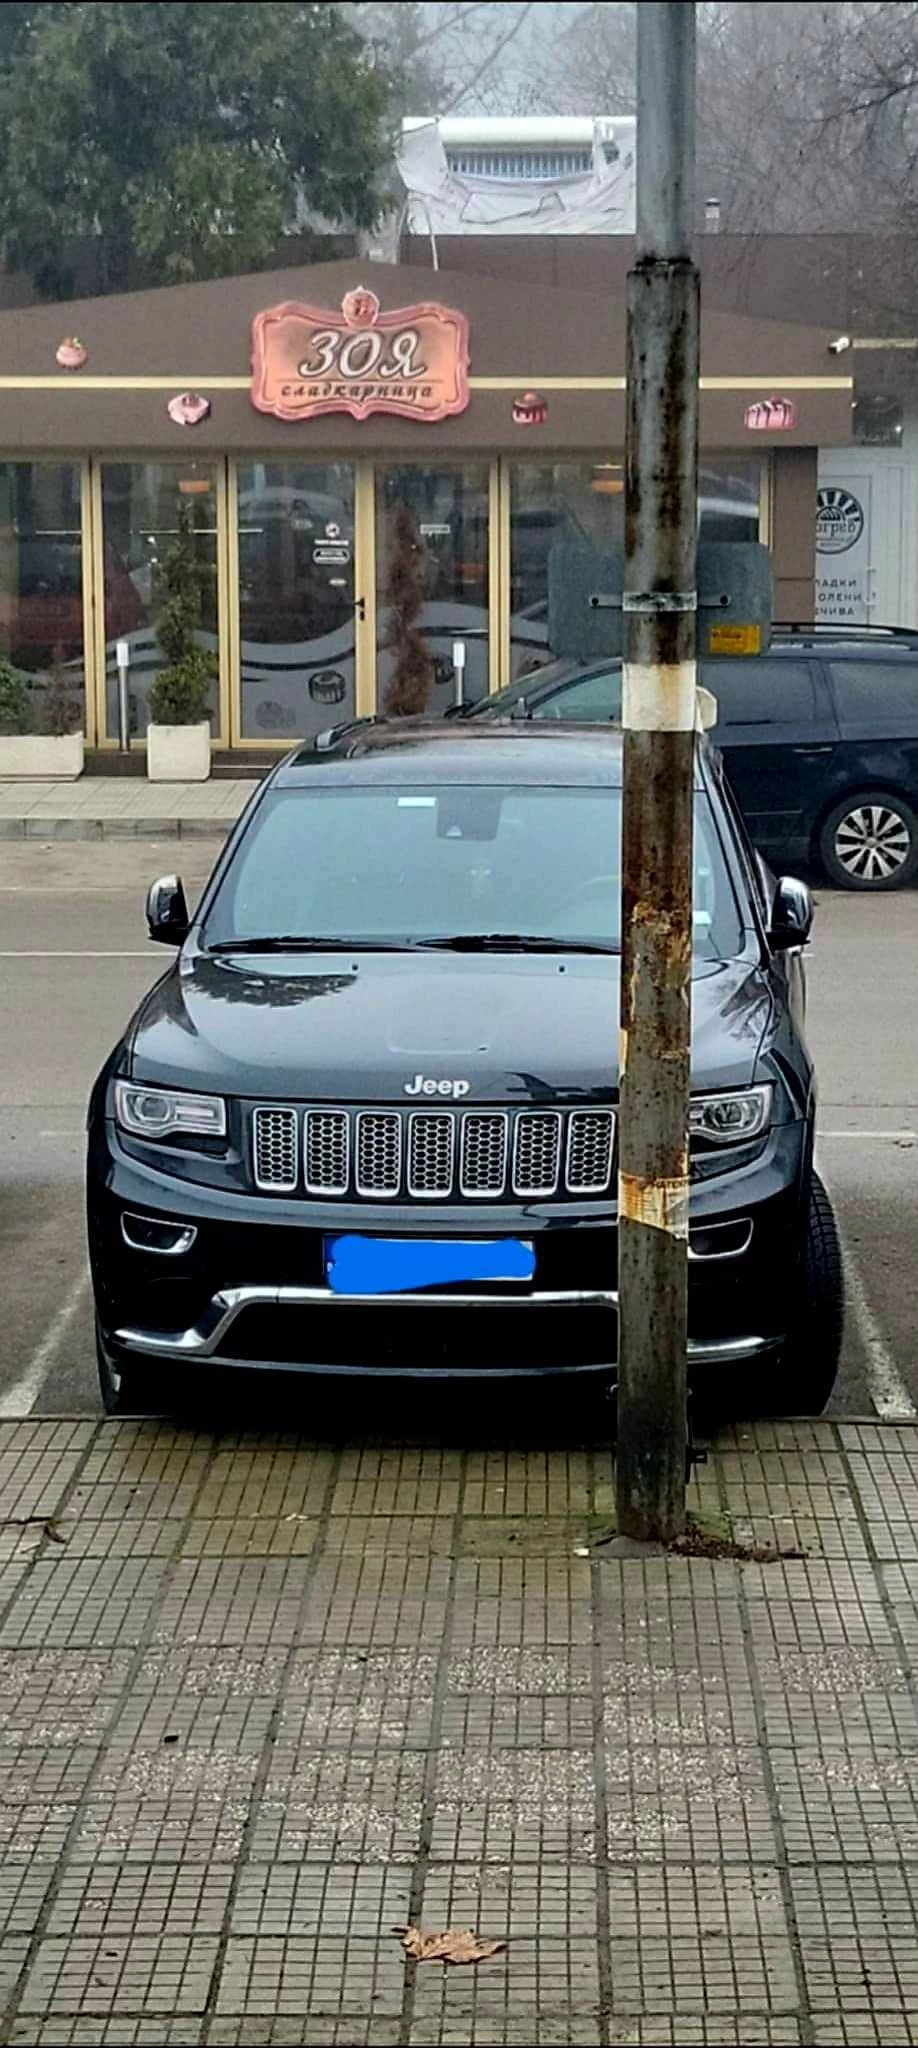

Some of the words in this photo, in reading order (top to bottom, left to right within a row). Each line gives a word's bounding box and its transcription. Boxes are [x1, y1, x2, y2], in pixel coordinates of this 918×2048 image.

[298, 328, 428, 379] ЗОЯ
[281, 381, 433, 402] сладкарница
[404, 1074, 471, 1099] Jeep
